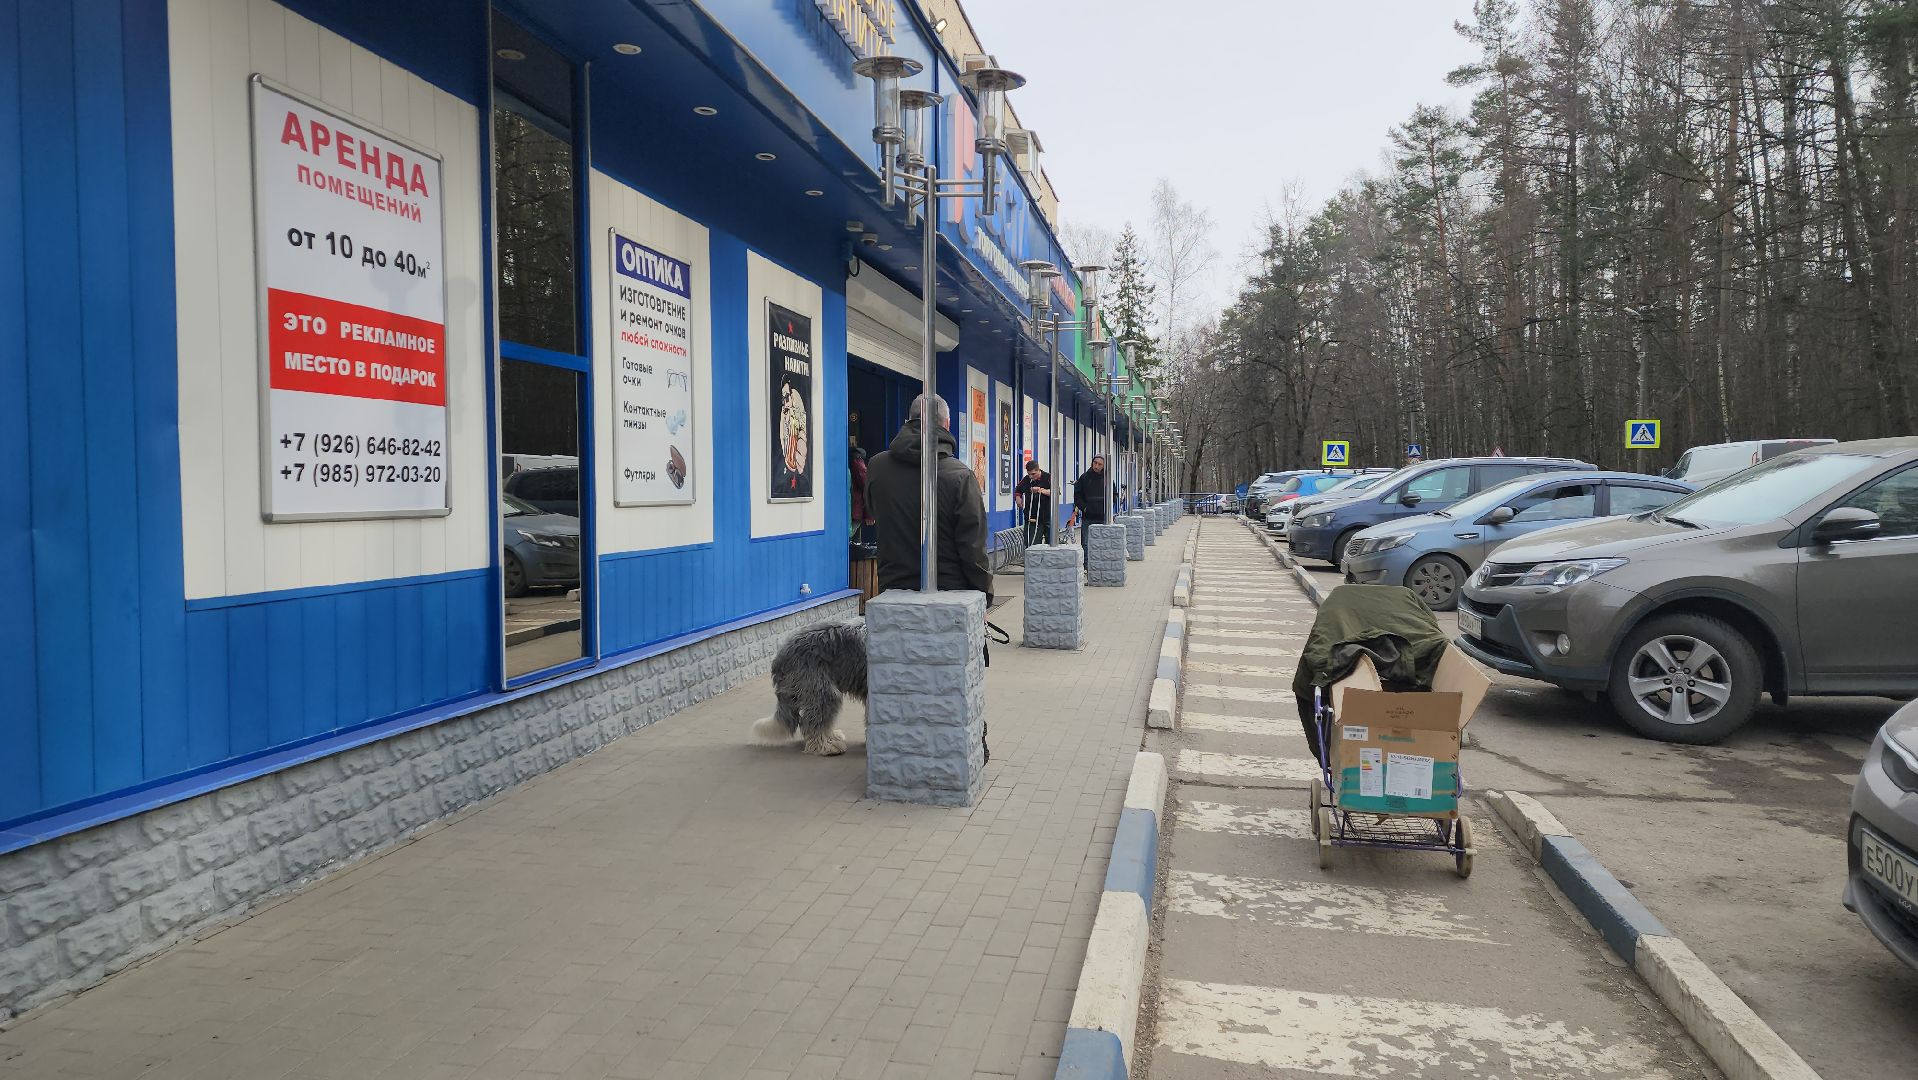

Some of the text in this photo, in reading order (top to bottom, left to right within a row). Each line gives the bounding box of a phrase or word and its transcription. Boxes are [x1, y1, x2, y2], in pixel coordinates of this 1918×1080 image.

[281, 111, 429, 198] АРЕНДА
[297, 163, 422, 223] ПОМЕЩЕНИЙ
[325, 231, 353, 259] 10
[621, 242, 684, 291] ОПТИКА
[619, 284, 686, 321] ИЗГОТОВЛЕНИЕ
[283, 312, 436, 354] ЭТО РЕКЛАМНОЕ
[629, 311, 663, 332] ремонт
[284, 352, 437, 388] МЕСТО В ПОДАРОК
[622, 356, 653, 375] Готовые
[622, 374, 642, 388] очки
[280, 432, 442, 458] +7 (926) 646-82-42
[280, 463, 441, 487] +7 (985) 972-03-20
[1866, 844, 1918, 898] Е500У
